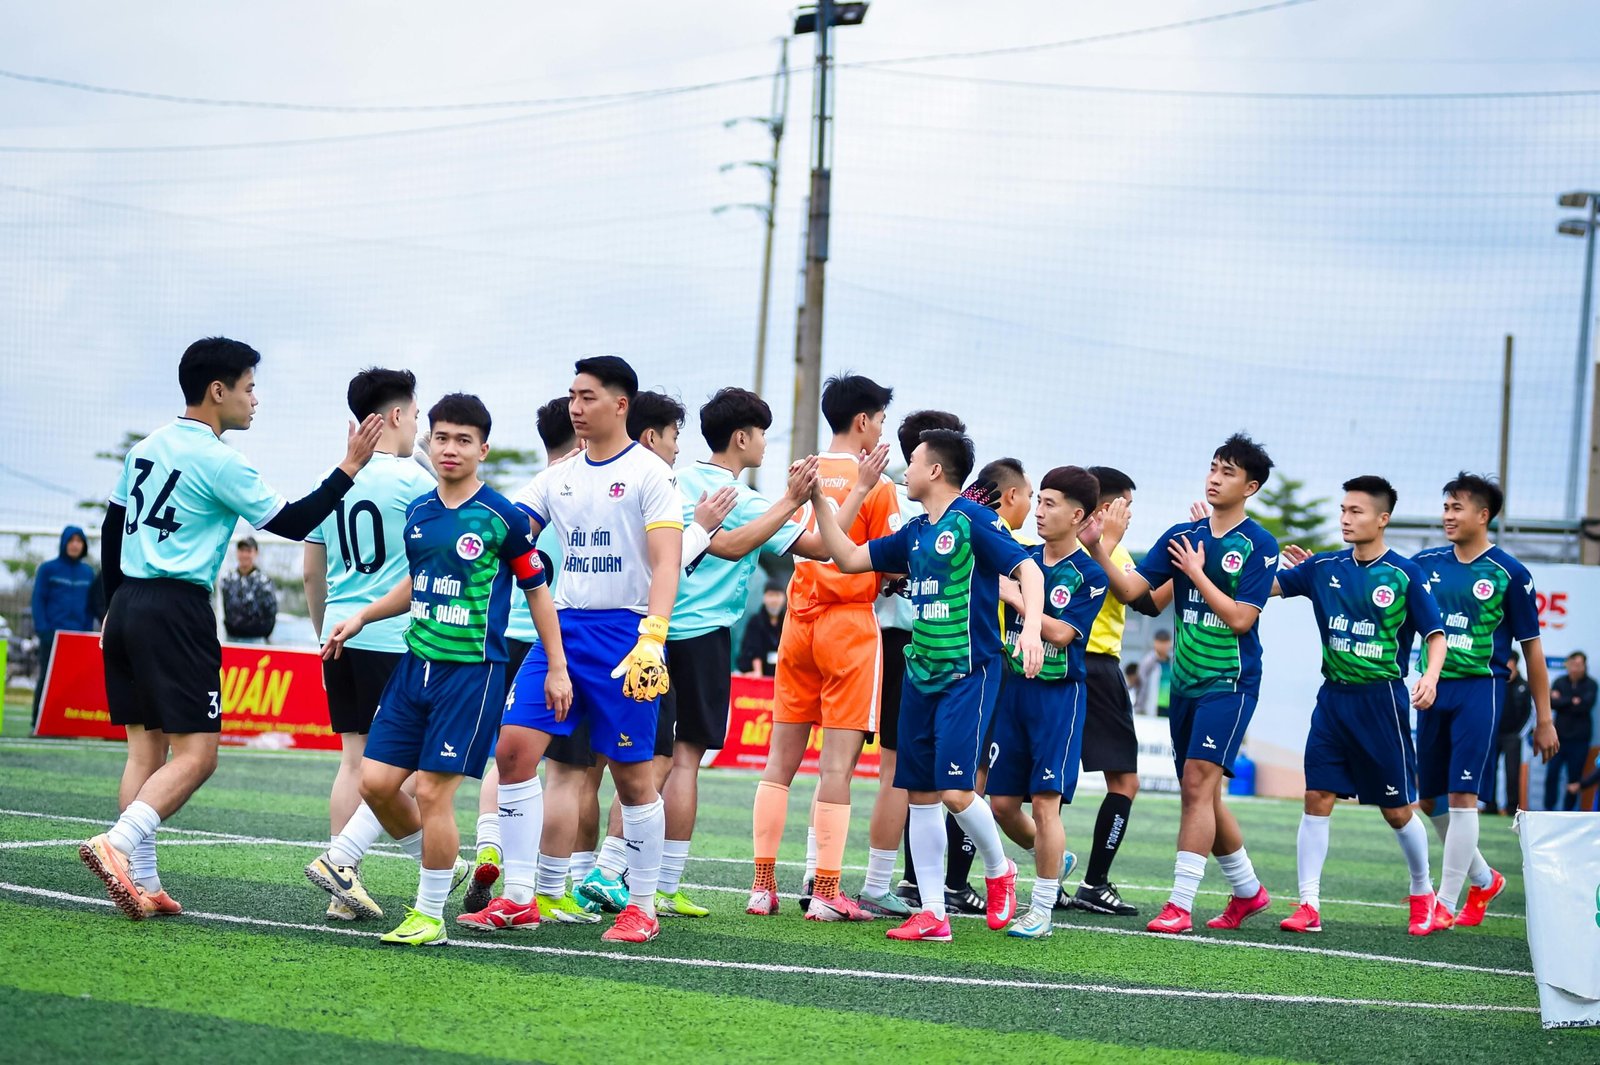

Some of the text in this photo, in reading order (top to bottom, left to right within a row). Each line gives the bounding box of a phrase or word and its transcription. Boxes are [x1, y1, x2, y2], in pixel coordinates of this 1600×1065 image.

[125, 457, 184, 544] 34
[334, 499, 387, 575] 10
[591, 553, 622, 574] QUÂN
[432, 574, 461, 597] NẤM
[435, 604, 470, 627] QUÂN
[923, 600, 950, 621] QUÂN
[1328, 613, 1349, 632] LẨU
[219, 654, 294, 718] UÁN
[207, 691, 222, 719] 3
